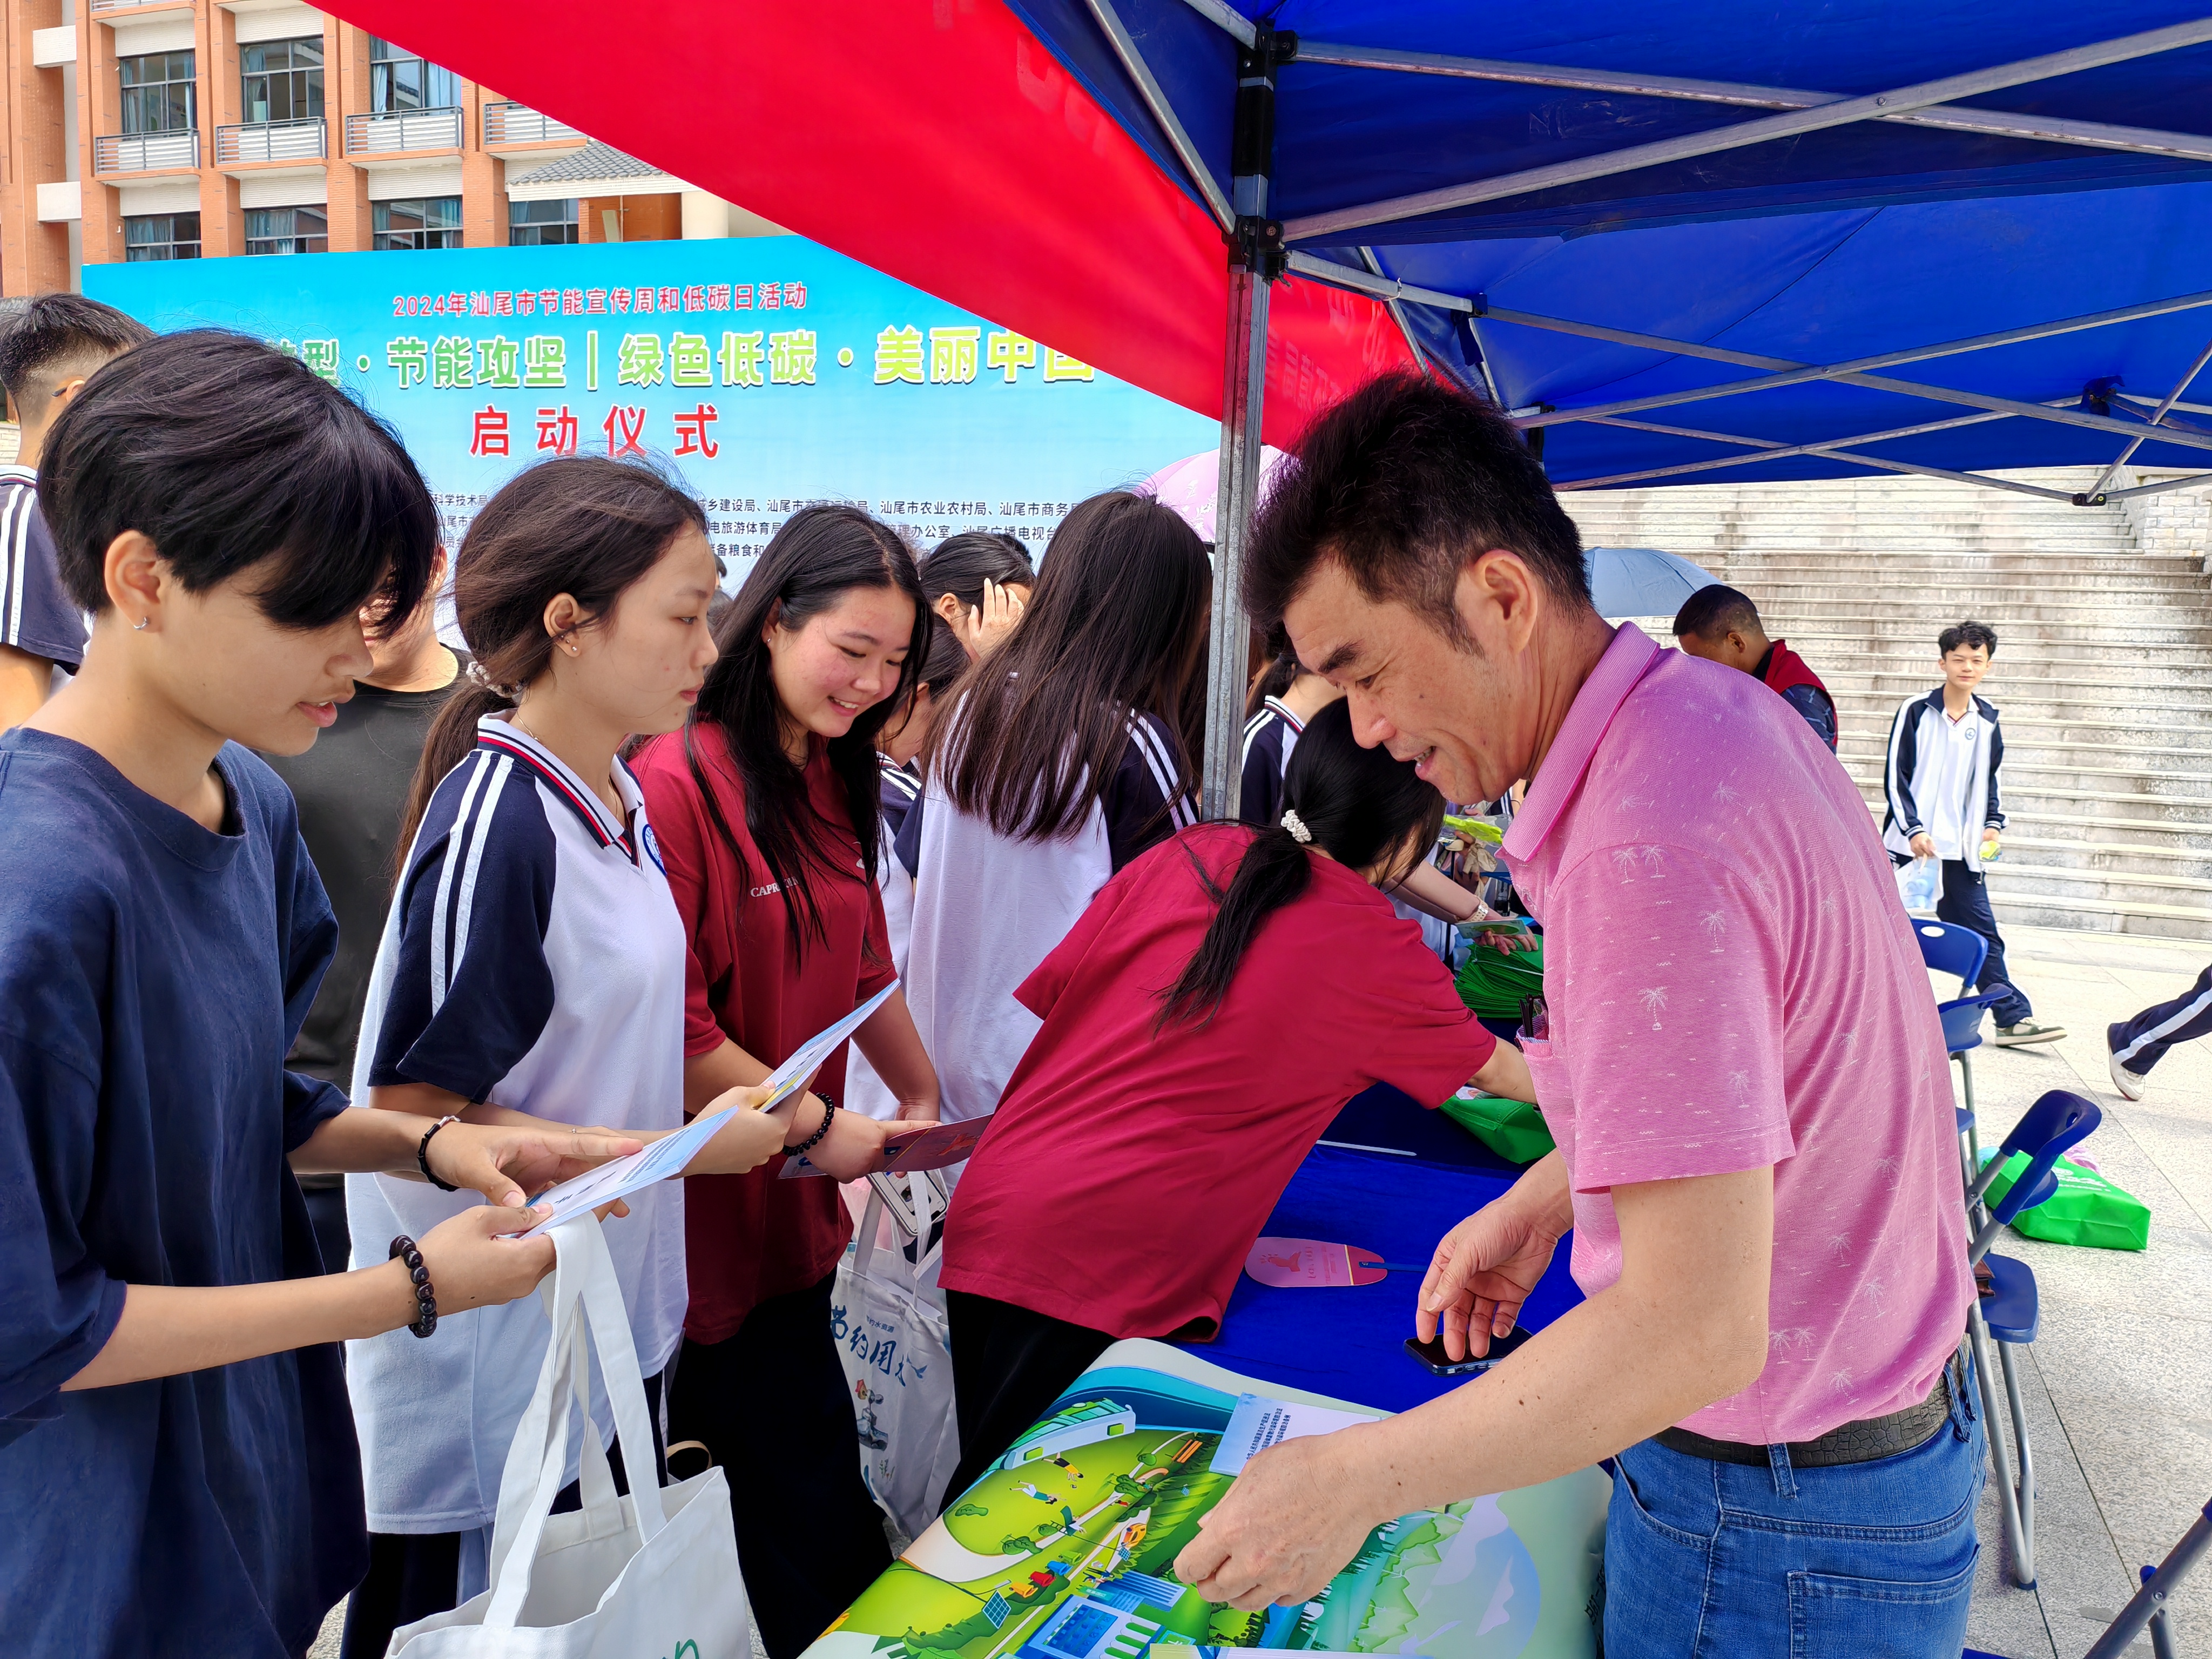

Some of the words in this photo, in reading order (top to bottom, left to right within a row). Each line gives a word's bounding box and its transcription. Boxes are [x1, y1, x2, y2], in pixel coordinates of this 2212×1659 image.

[393, 281, 808, 318] 2024年汕尾市节能宣传周和低碳日活动
[470, 402, 720, 459] 启动仪式
